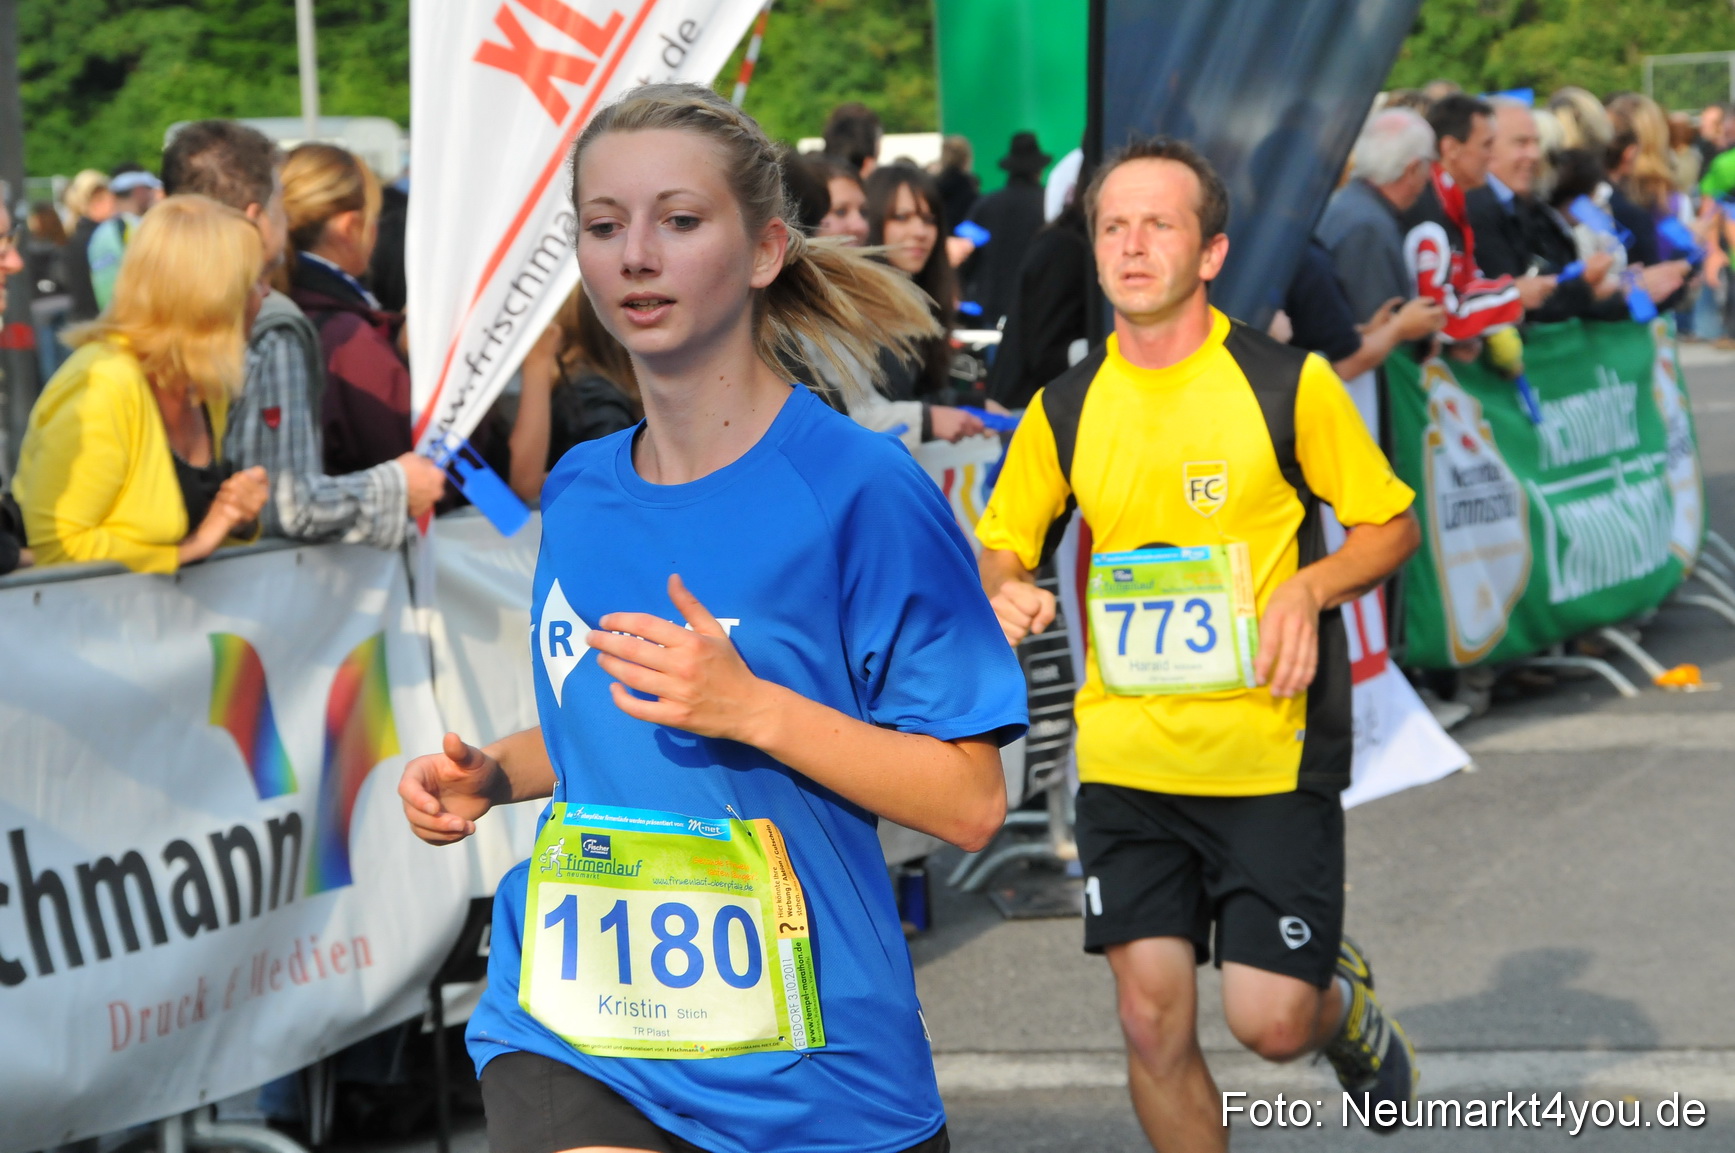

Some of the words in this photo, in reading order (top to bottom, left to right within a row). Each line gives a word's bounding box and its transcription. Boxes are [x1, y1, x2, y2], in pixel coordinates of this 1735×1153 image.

[1190, 478, 1221, 501] FC
[549, 620, 574, 657] R
[1104, 598, 1218, 657] 773
[584, 841, 610, 852] Fischer
[766, 824, 780, 855] Gutschein
[566, 853, 643, 877] firmenlauf
[566, 871, 600, 880] neumarkt
[778, 860, 788, 881] Aktion
[785, 887, 793, 918] Werbung
[544, 895, 763, 990] 1180
[779, 922, 805, 934] ?
[783, 958, 798, 1002] 3.10.2011
[793, 941, 816, 1044] www.tempel-marathon.de
[107, 976, 208, 1053] Druck
[598, 994, 667, 1019] Kristin
[677, 1008, 708, 1020] Stich
[633, 1026, 645, 1036] TR
[646, 1027, 670, 1037] Plast
[789, 1003, 806, 1047] ETSDORF
